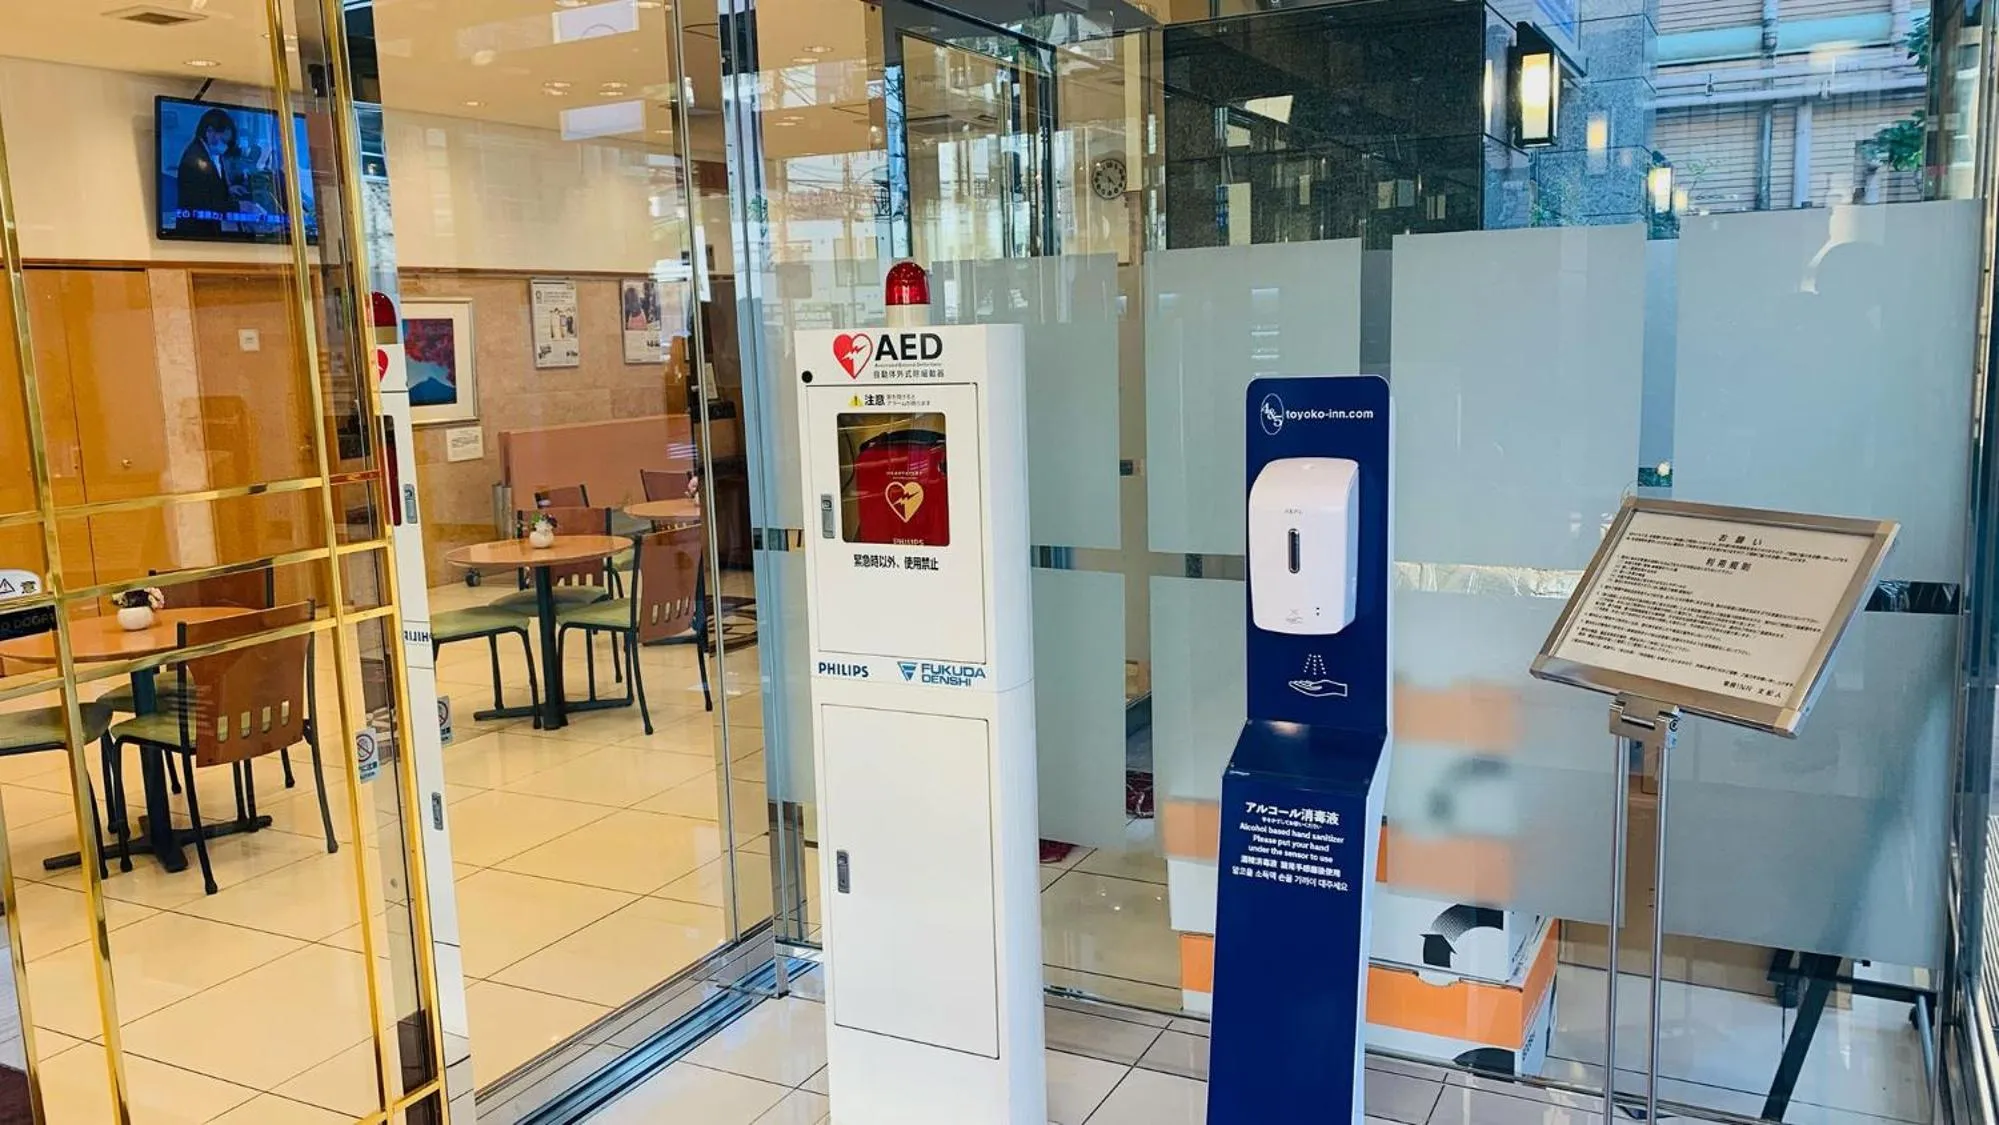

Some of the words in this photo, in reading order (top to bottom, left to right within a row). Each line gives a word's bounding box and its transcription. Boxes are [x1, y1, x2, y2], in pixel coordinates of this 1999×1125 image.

[874, 333, 943, 361] AED
[864, 394, 885, 406] 注意
[1285, 409, 1374, 420] toyoko-inn.com
[818, 662, 869, 678] PHILIPS
[921, 663, 986, 679] FUKUDA
[921, 675, 972, 687] DENSHI
[1245, 801, 1340, 826] アルコール消毒液
[1239, 822, 1267, 833] Alcohol
[1268, 826, 1291, 836] based
[1291, 829, 1311, 839] hand
[1312, 833, 1344, 843] sanitizer
[1252, 834, 1277, 844] Please
[1277, 839, 1291, 847] put
[1292, 841, 1309, 849] your
[1309, 842, 1330, 852] hand
[1248, 845, 1270, 854] under
[1270, 847, 1283, 855] the
[1284, 850, 1309, 859] sensor
[1310, 853, 1318, 861] to
[1319, 855, 1333, 863] use
